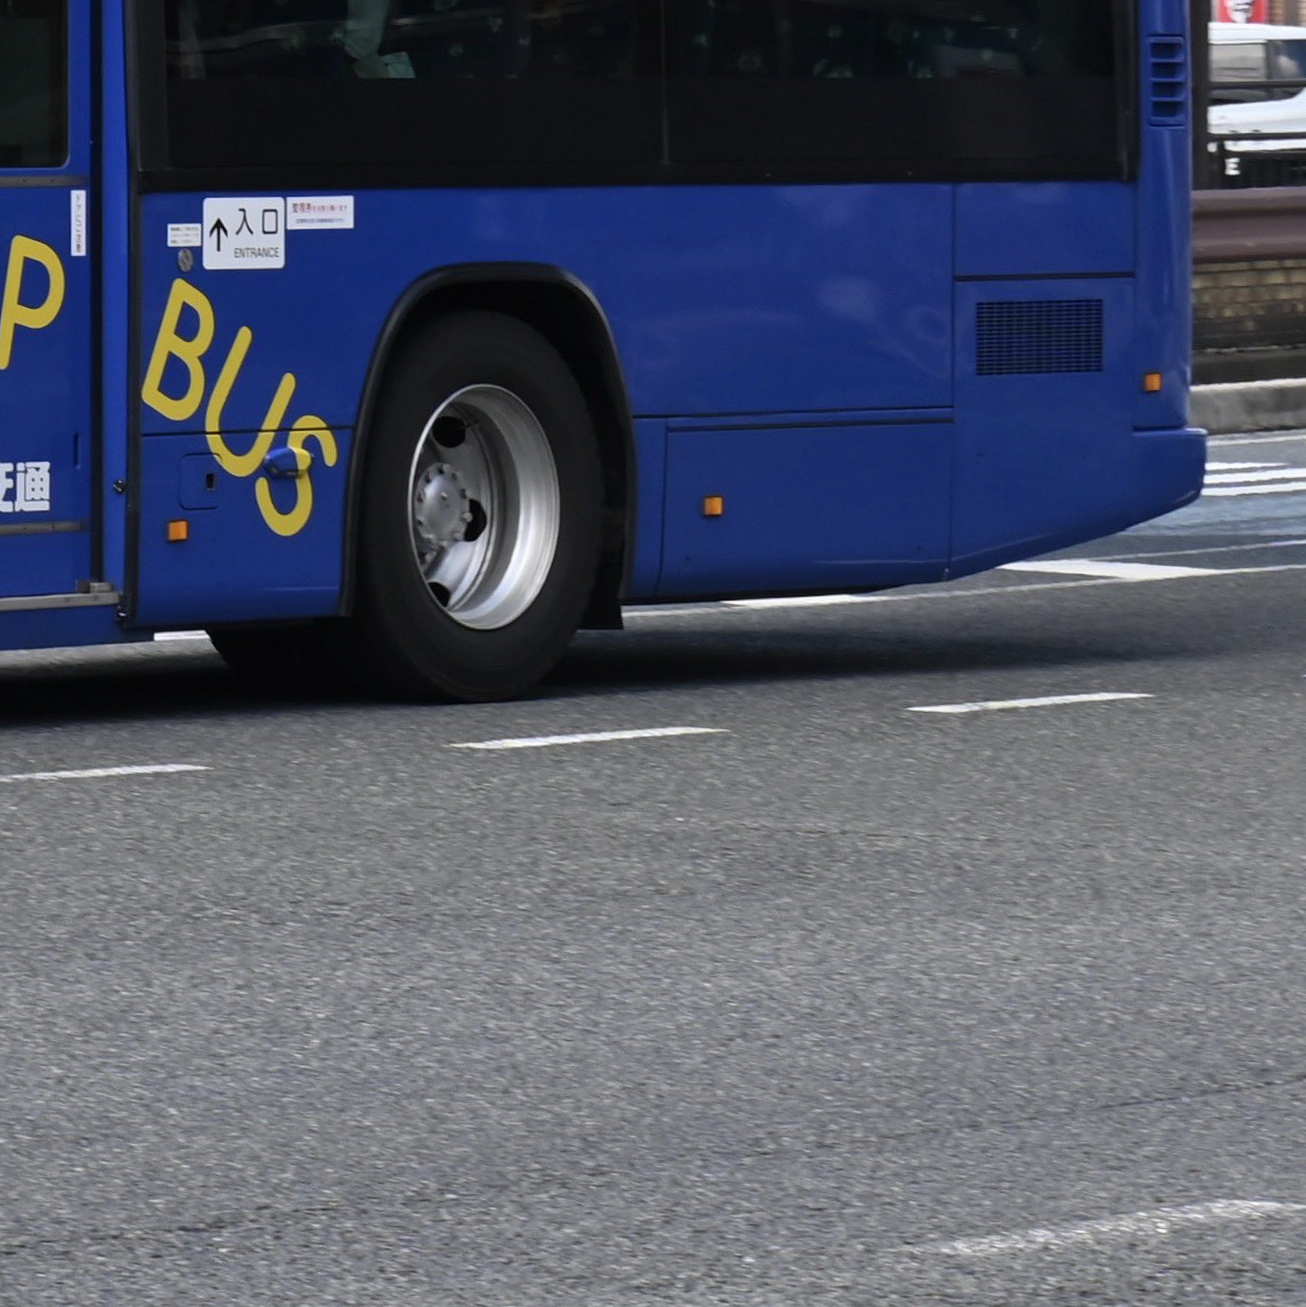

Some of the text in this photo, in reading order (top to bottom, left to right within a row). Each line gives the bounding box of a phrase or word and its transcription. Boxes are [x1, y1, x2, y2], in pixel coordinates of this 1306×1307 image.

[235, 208, 278, 235] 入口
[234, 247, 279, 258] ENTRANCE
[141, 278, 338, 536] BUS
